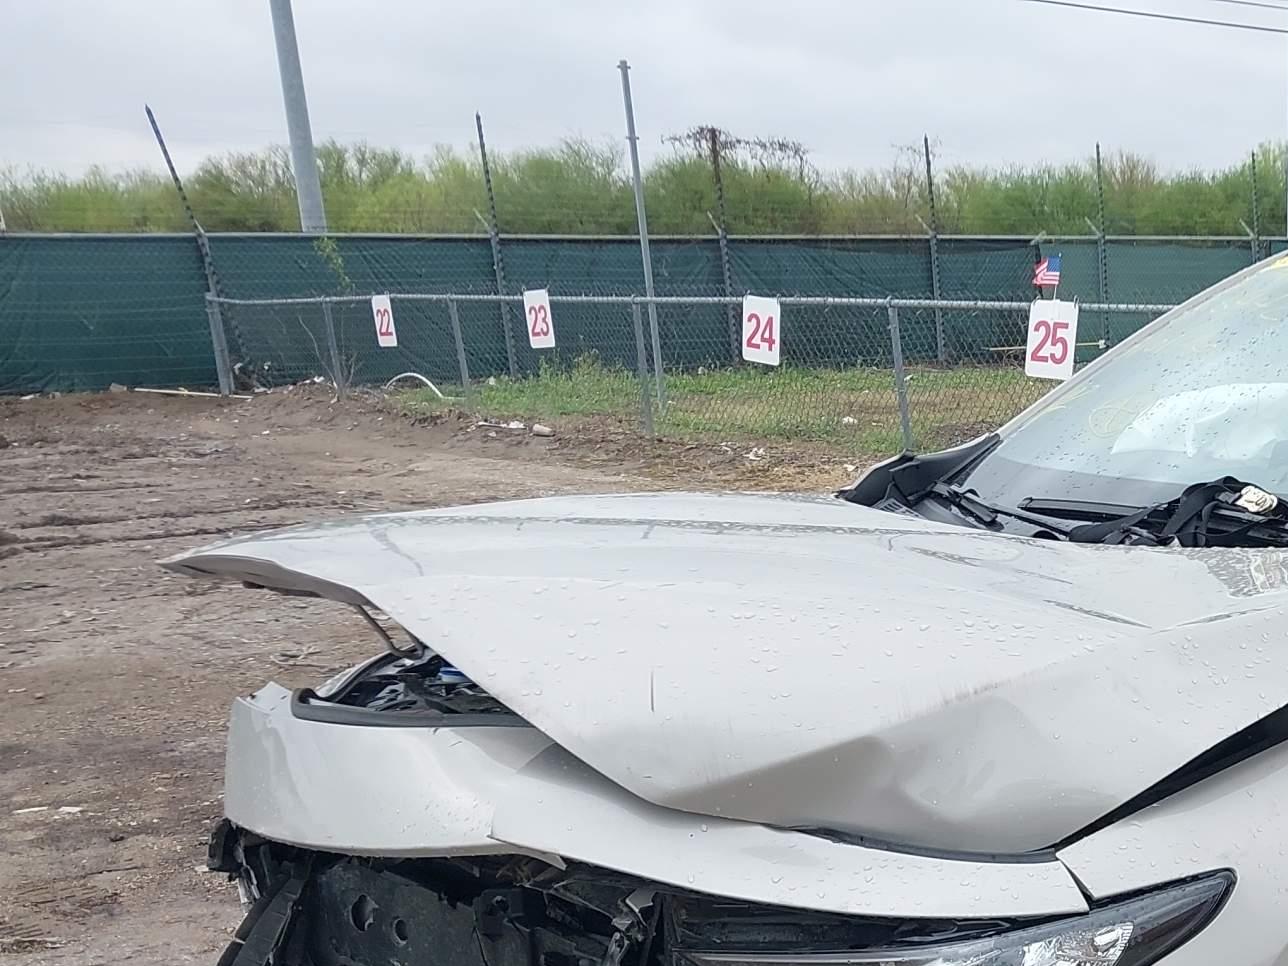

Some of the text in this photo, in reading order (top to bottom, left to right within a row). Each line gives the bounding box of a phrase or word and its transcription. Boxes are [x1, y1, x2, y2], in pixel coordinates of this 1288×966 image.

[376, 308, 393, 337] 22
[528, 304, 550, 337] 23
[746, 312, 776, 352] 24
[1030, 320, 1070, 365] 25
